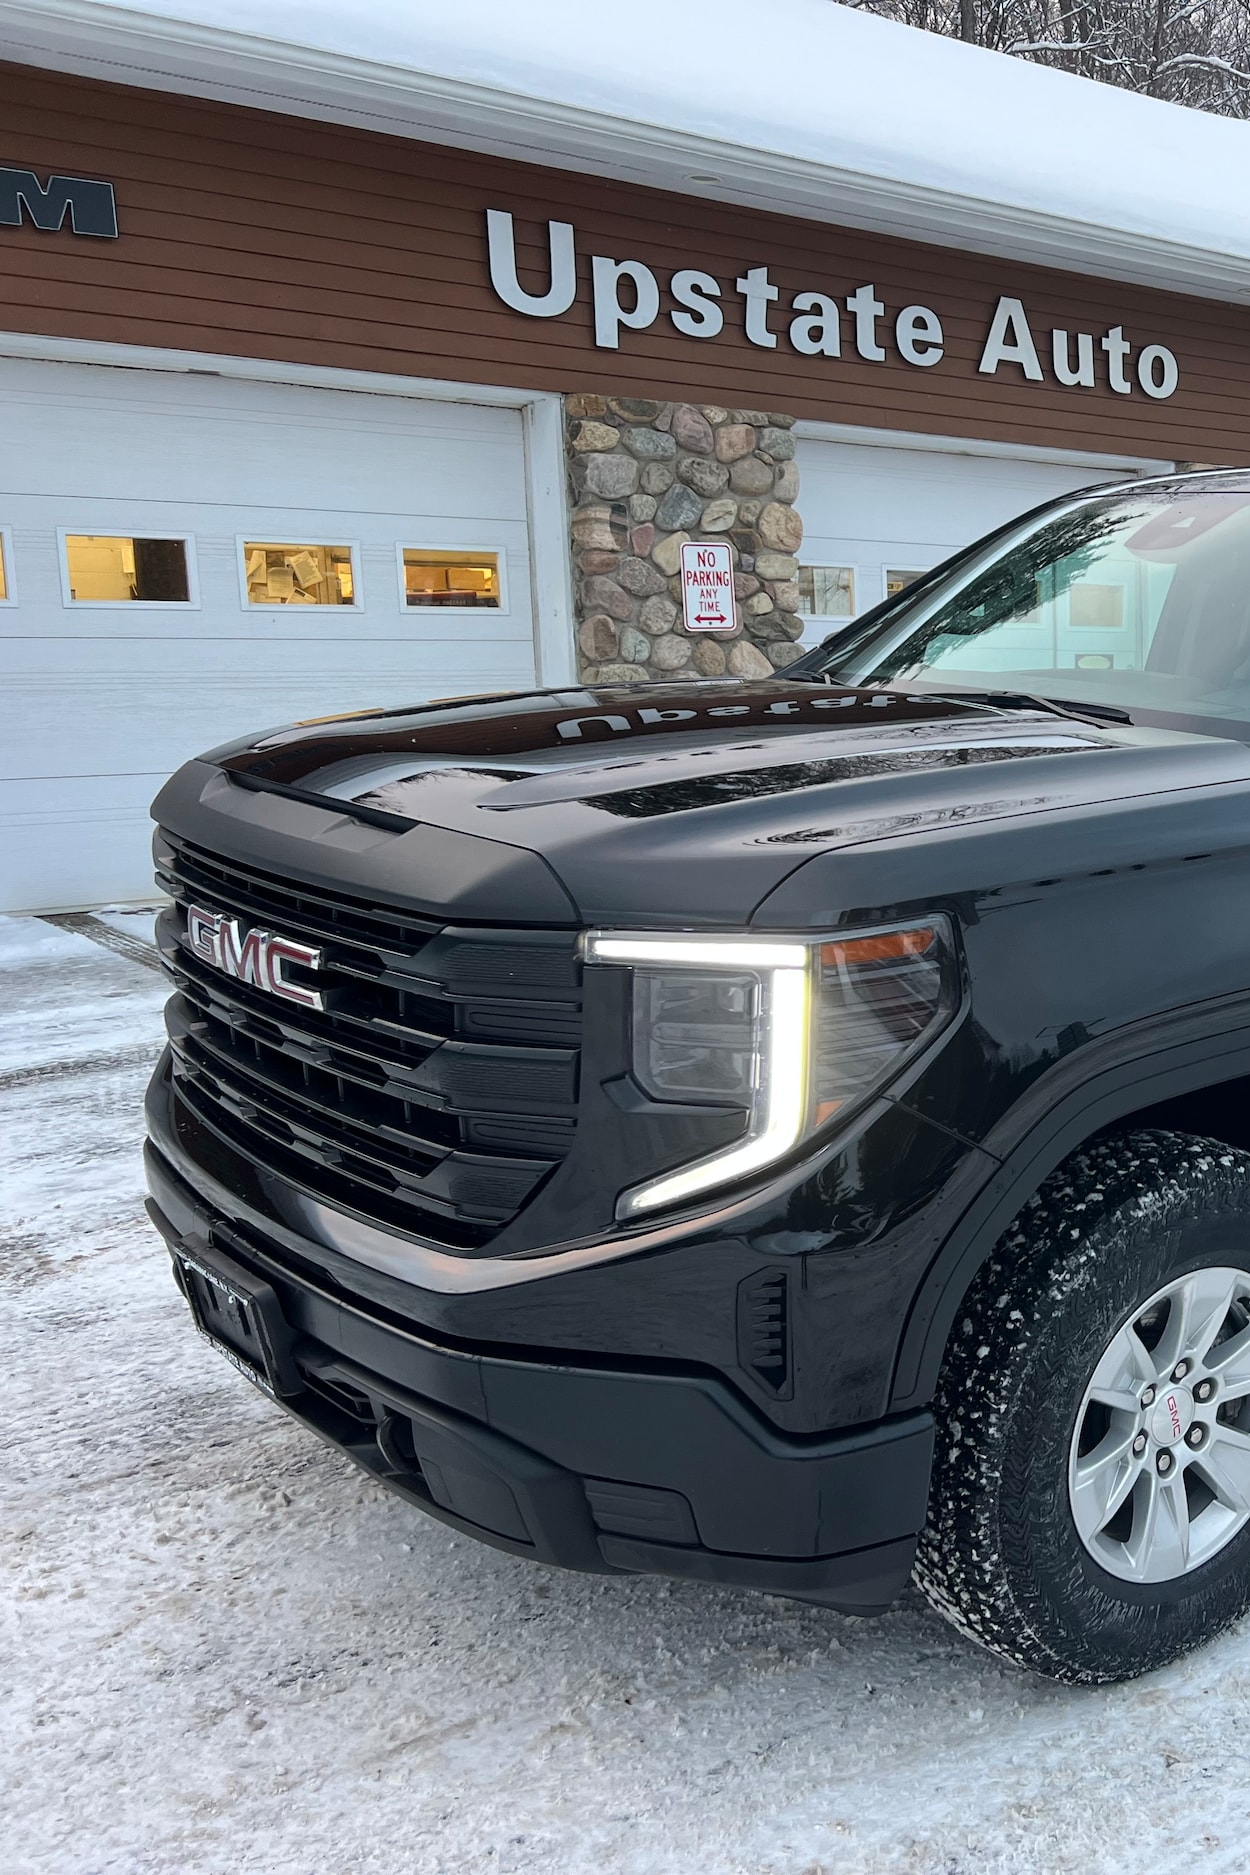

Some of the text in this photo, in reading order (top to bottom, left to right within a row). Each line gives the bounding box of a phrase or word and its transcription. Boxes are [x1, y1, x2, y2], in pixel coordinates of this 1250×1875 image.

[487, 209, 1179, 400] Upstate Auto
[697, 552, 716, 568] NO
[686, 571, 730, 587] PARKING
[700, 588, 718, 599] ANY
[699, 601, 721, 612] TIME
[188, 903, 324, 1011] GMC
[1167, 1395, 1181, 1439] GMC
